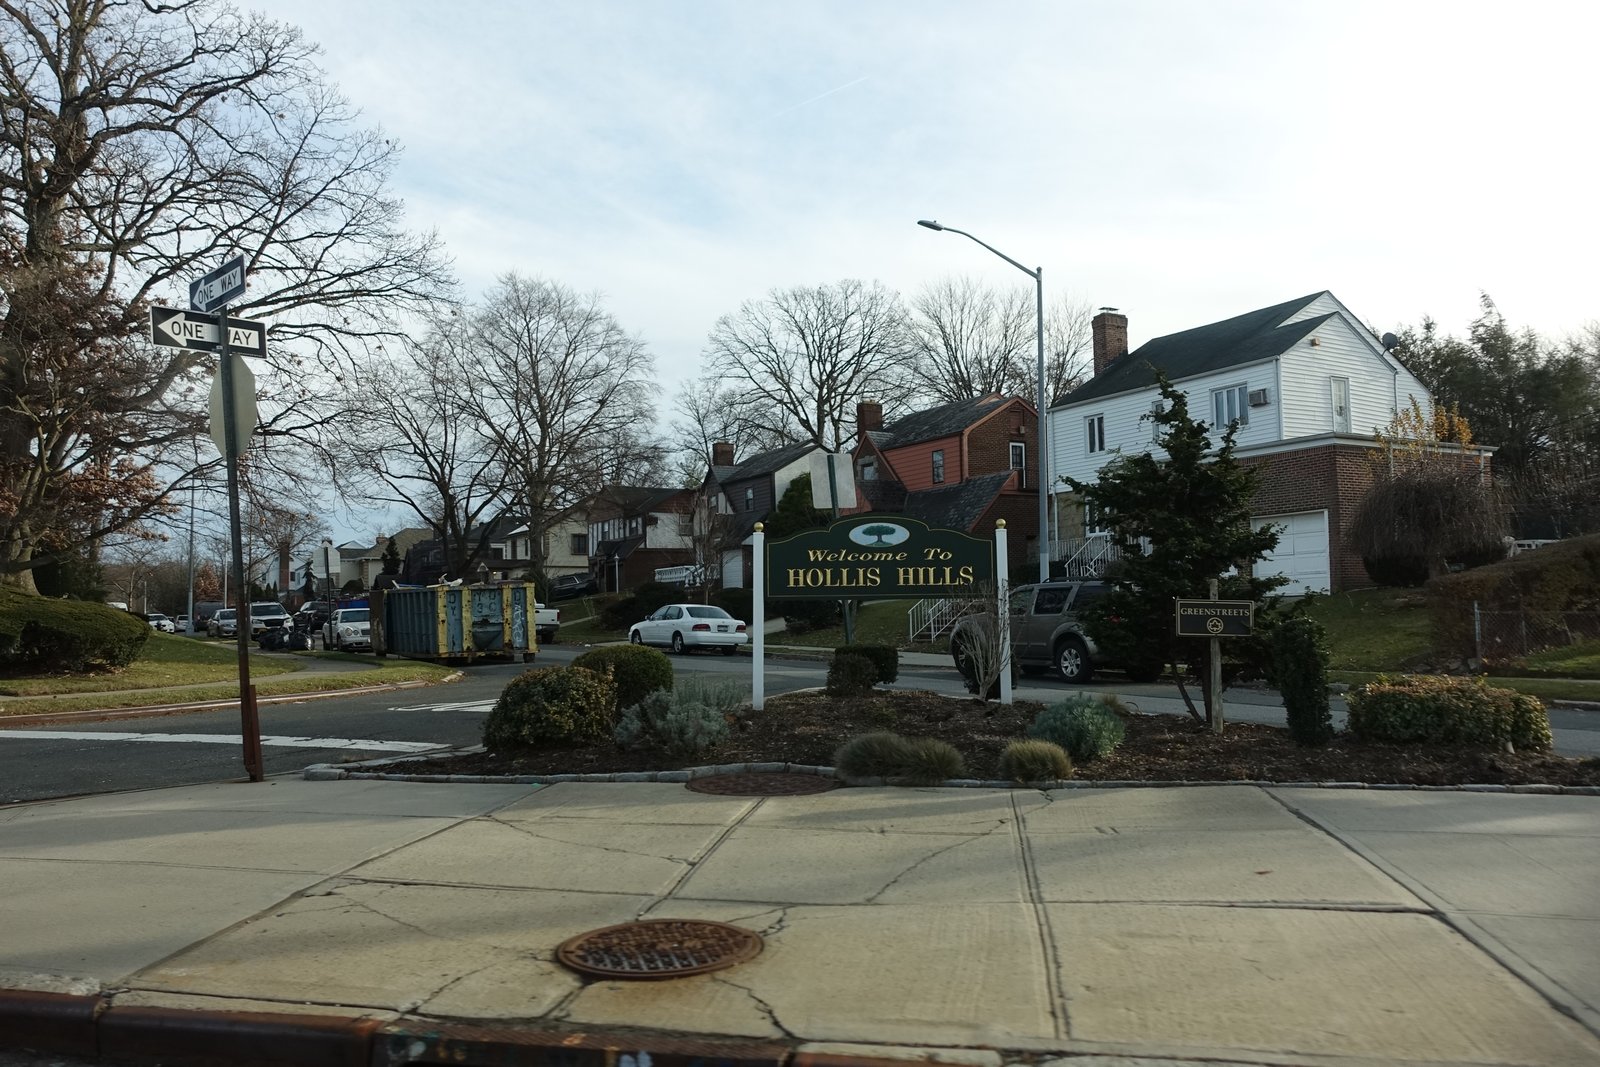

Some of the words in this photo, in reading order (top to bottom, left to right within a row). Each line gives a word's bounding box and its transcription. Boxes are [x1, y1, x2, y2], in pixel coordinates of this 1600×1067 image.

[198, 284, 214, 304] ONE
[220, 269, 238, 293] WAY
[171, 321, 205, 339] ONE
[228, 328, 252, 346] AY
[807, 548, 908, 562] Welcome
[923, 547, 953, 561] To
[787, 567, 881, 588] HOLLIS
[897, 565, 974, 587] HILLS
[1180, 608, 1250, 616] GREENSTREETS
